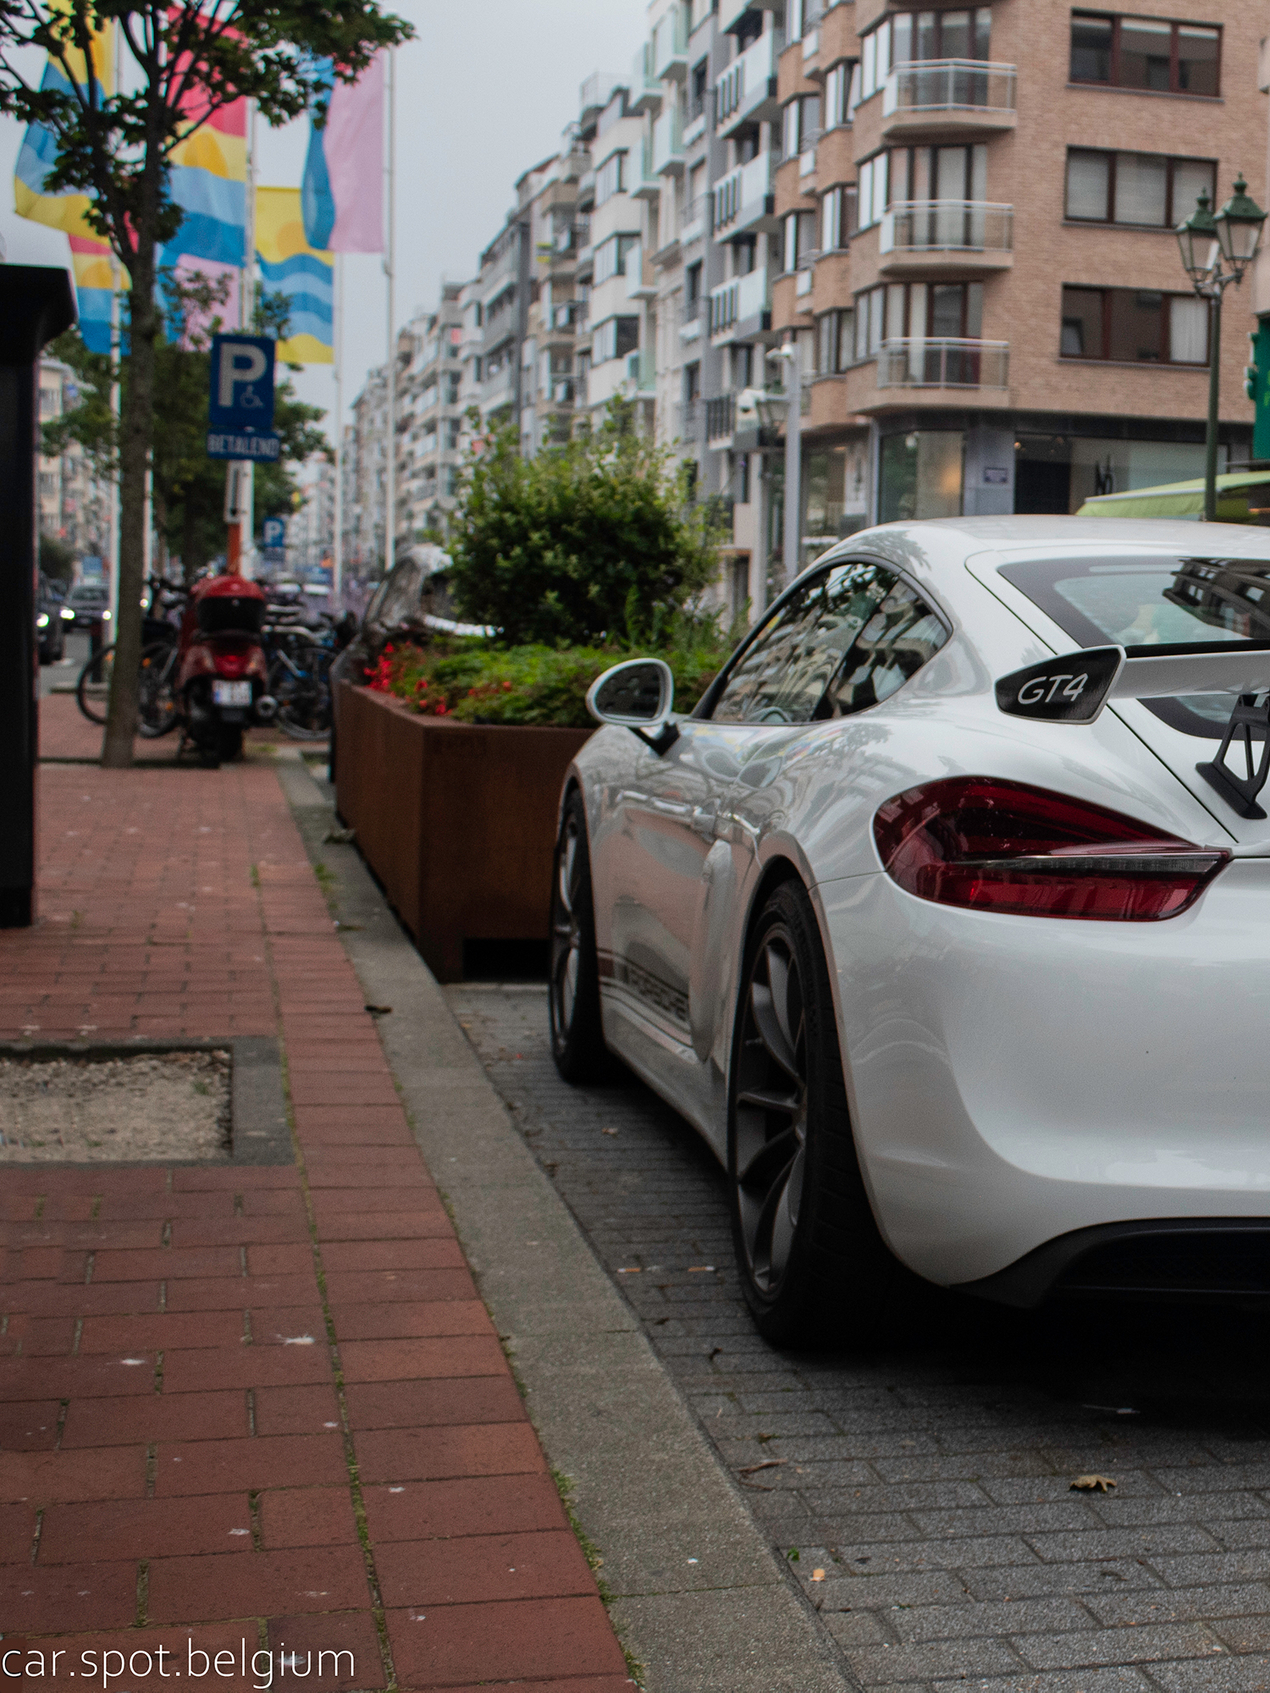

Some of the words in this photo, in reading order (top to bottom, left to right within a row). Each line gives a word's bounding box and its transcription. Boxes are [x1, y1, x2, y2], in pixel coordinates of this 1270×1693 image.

[219, 342, 267, 408] P
[207, 433, 280, 457] BETALEND
[264, 521, 281, 543] P
[1017, 672, 1089, 705] GT4
